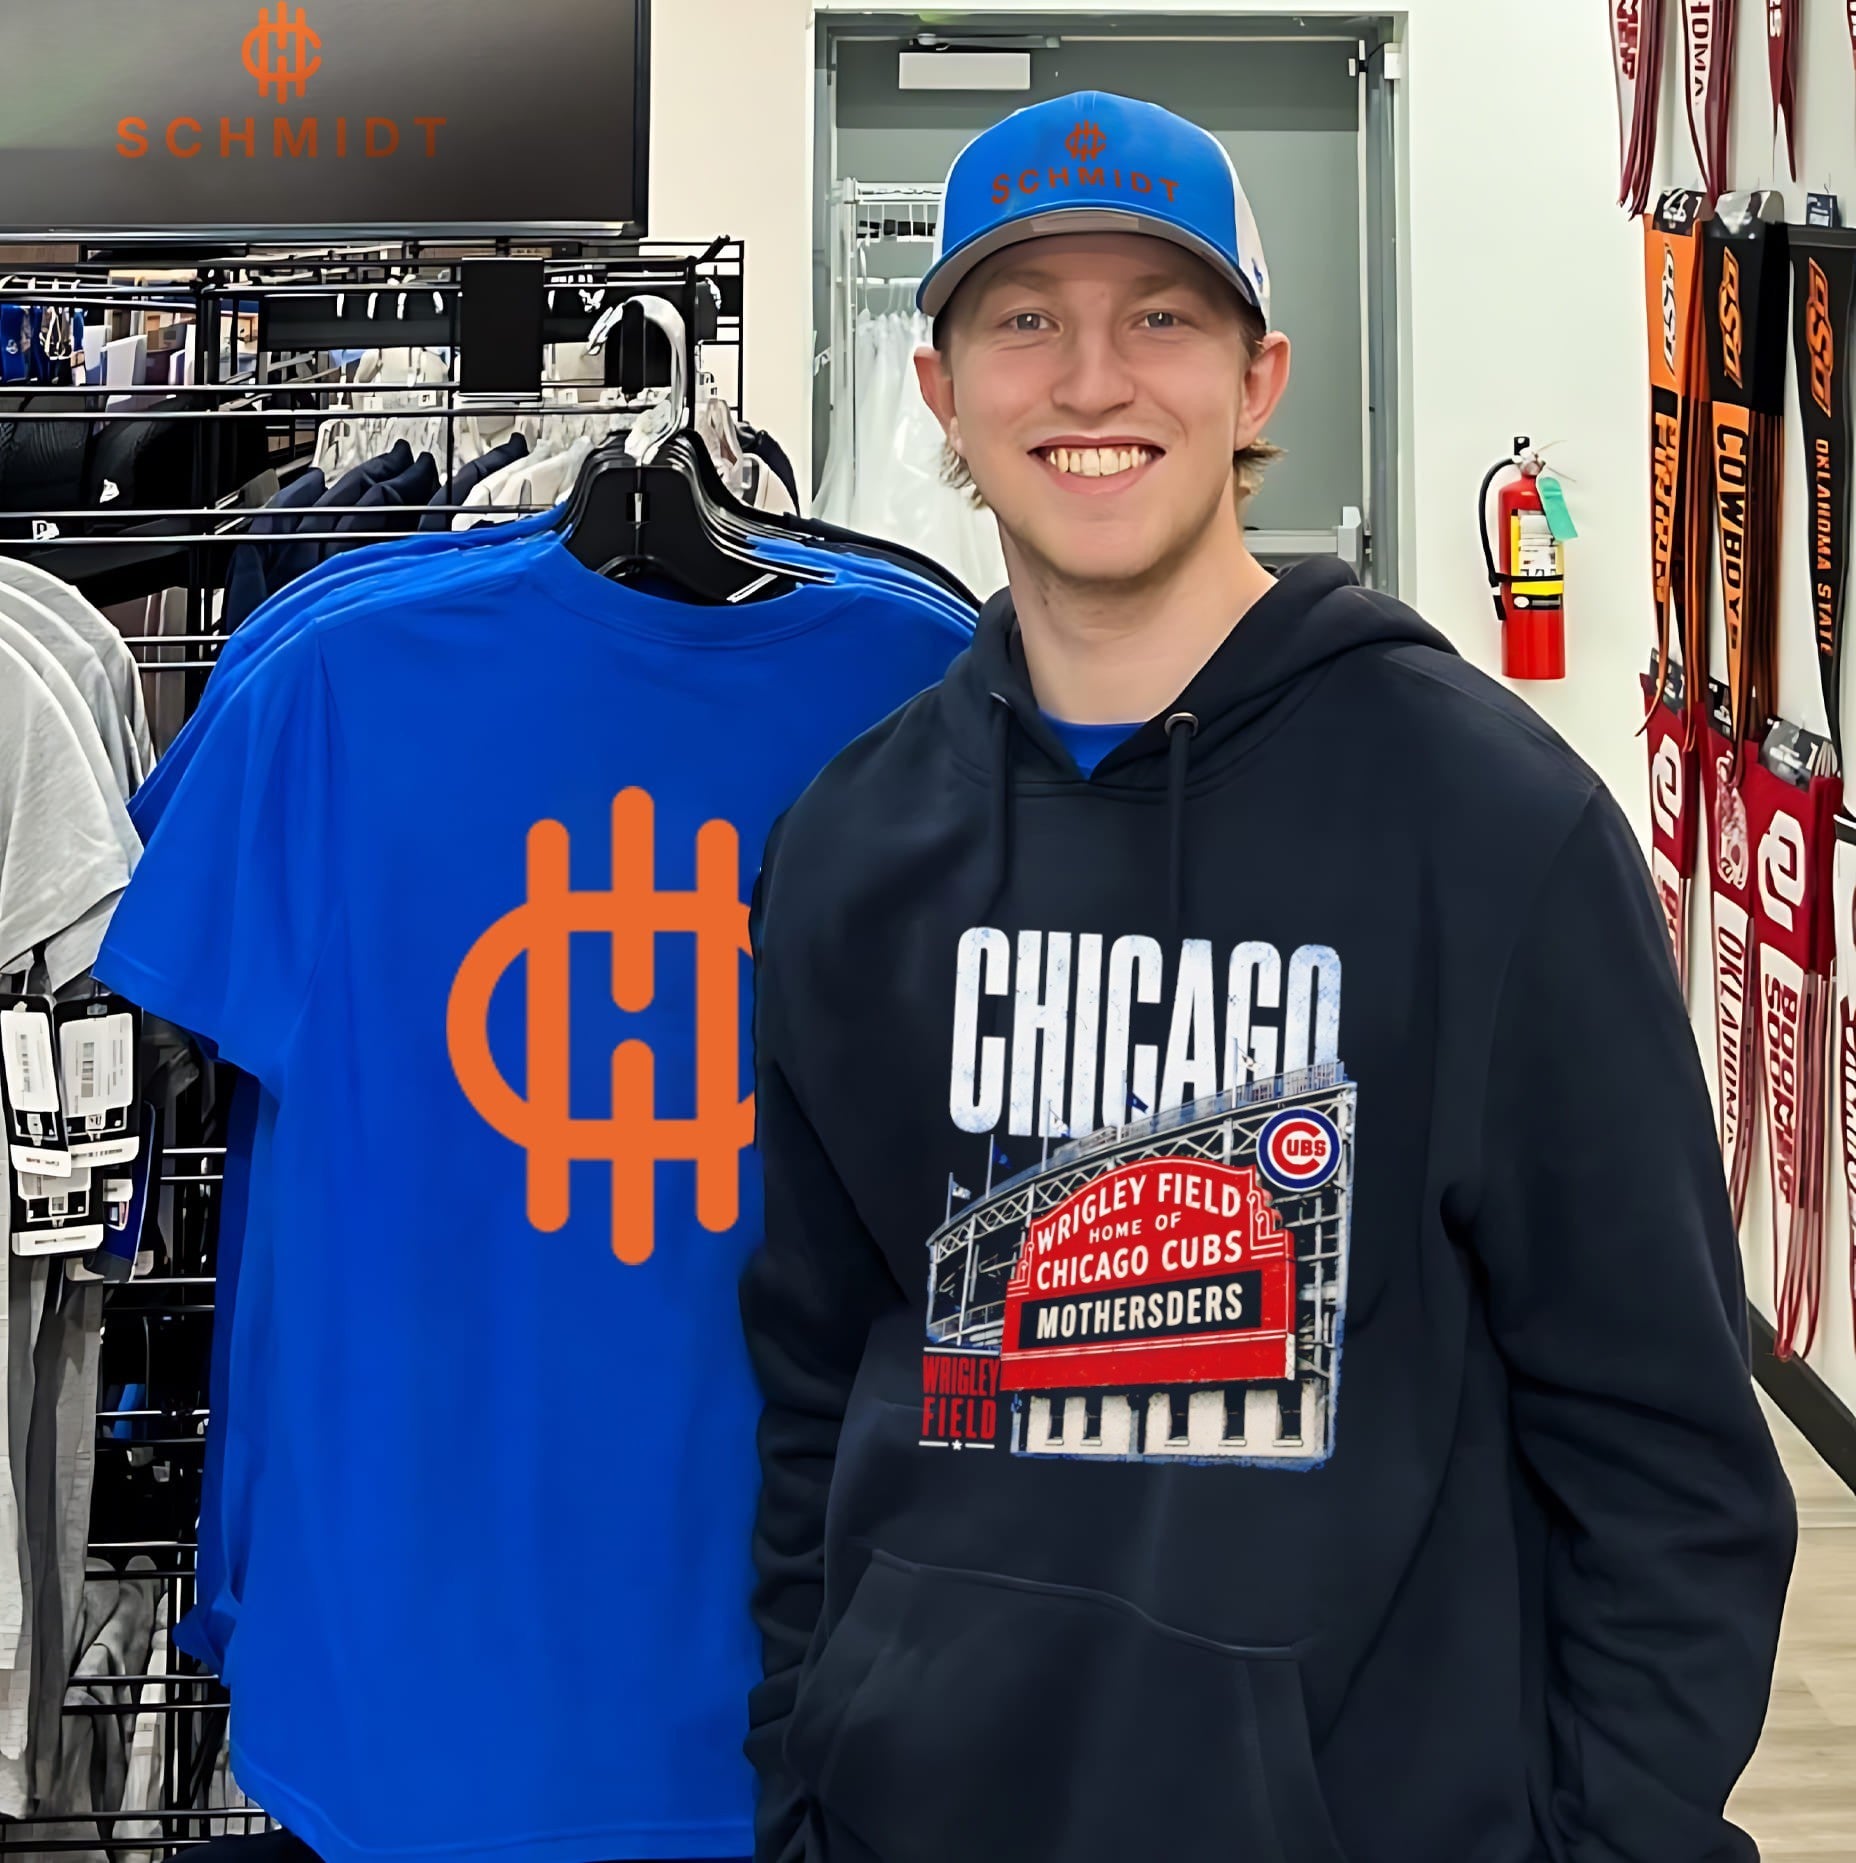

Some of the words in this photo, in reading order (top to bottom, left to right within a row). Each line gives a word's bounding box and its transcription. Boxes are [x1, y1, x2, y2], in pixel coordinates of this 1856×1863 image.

[115, 116, 448, 159] SCHMIDT
[991, 166, 1180, 204] SCHMIDT
[1815, 438, 1832, 571] OKLAHOMA
[950, 926, 1342, 1139] CHICAGO
[1037, 1174, 1147, 1256] WRIGLEY
[1158, 1172, 1242, 1218] FIELD
[1089, 1218, 1143, 1244] HOME
[1155, 1211, 1182, 1231] OF
[1036, 1245, 1149, 1291] CHICAGO
[1161, 1230, 1243, 1272] CUBS
[1036, 1282, 1244, 1340] MOTHERSDERS
[921, 1396, 997, 1439] FIELD
